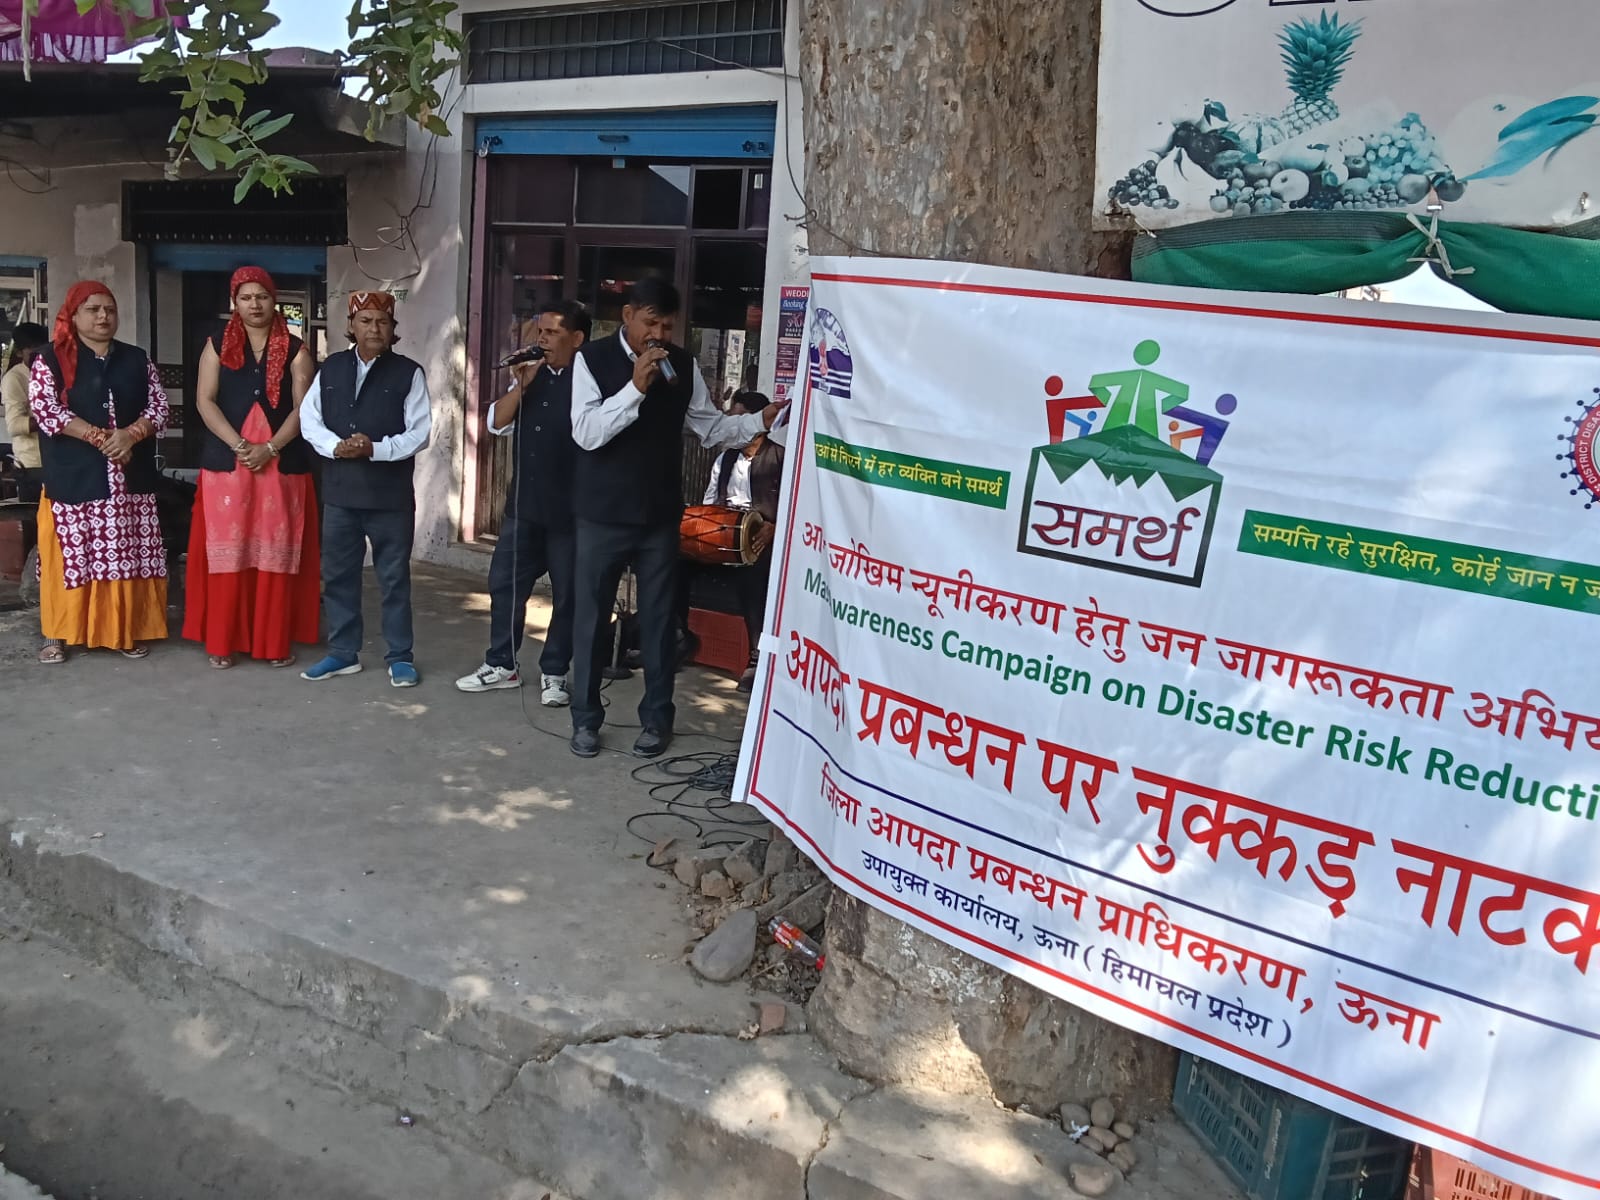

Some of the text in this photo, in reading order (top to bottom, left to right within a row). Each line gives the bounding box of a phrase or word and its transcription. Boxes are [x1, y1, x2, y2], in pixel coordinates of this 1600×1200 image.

[864, 454, 877, 473] में
[878, 461, 896, 478] हर
[898, 463, 938, 485] व्यक्ति
[941, 469, 962, 490] बने
[965, 476, 1003, 496] समर्थ
[1031, 499, 1201, 567] समर्थ
[1579, 439, 1598, 484] DISTRICT
[828, 537, 905, 594] जोखिम
[909, 568, 1068, 635] न्यूनीकरण
[1072, 596, 1131, 664] हेतु
[1138, 621, 1207, 667] जन
[1214, 637, 1455, 722] जागरूकता
[1253, 524, 1322, 551] सम्पत्ति
[1325, 532, 1355, 560] रहे
[1451, 553, 1502, 587] कोई
[1505, 565, 1555, 591] जान
[1559, 575, 1580, 595] न
[941, 629, 1092, 695] Campaign
[1102, 677, 1146, 709] on
[1157, 684, 1315, 749] Disaster
[1324, 723, 1413, 775] Risk
[857, 678, 1027, 794] प्रबन्धन
[1036, 738, 1120, 825] पर
[1131, 766, 1376, 919] नुक्कड़
[821, 761, 1442, 1050] जिला आपदा प्रबन्धन प्राधिकरण, ऊना
[861, 849, 930, 897] उपायुक्त
[1032, 925, 1080, 960] ऊना
[1101, 947, 1202, 1011] हिमाचल
[1206, 996, 1274, 1038] प्रदेश
